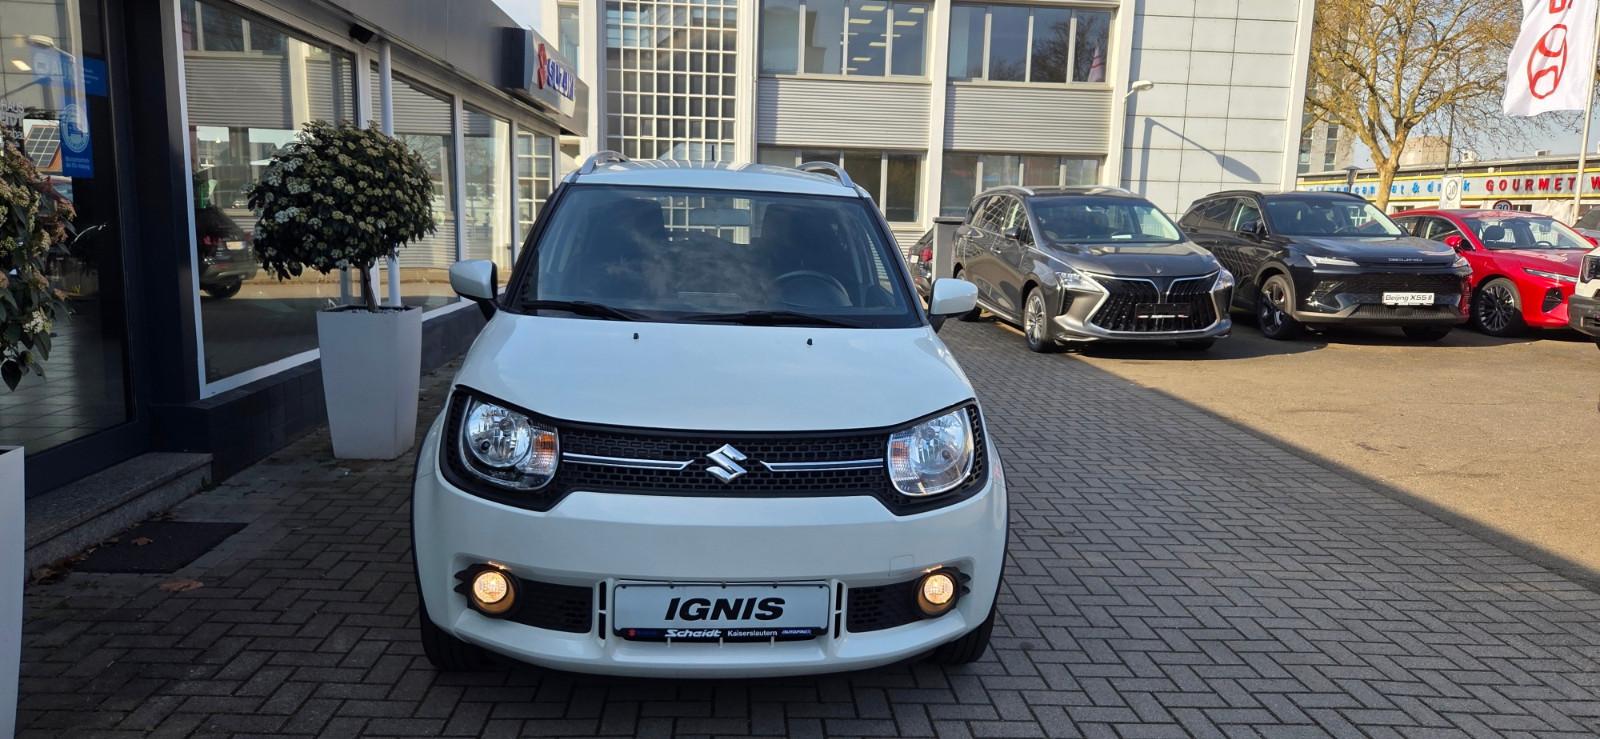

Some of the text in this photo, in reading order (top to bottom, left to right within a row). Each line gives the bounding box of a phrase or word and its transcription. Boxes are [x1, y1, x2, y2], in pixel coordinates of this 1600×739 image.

[1412, 182, 1420, 193] &
[1485, 176, 1576, 192] GOURMET
[664, 597, 786, 621] IGNIS
[664, 629, 722, 638] Scheidt
